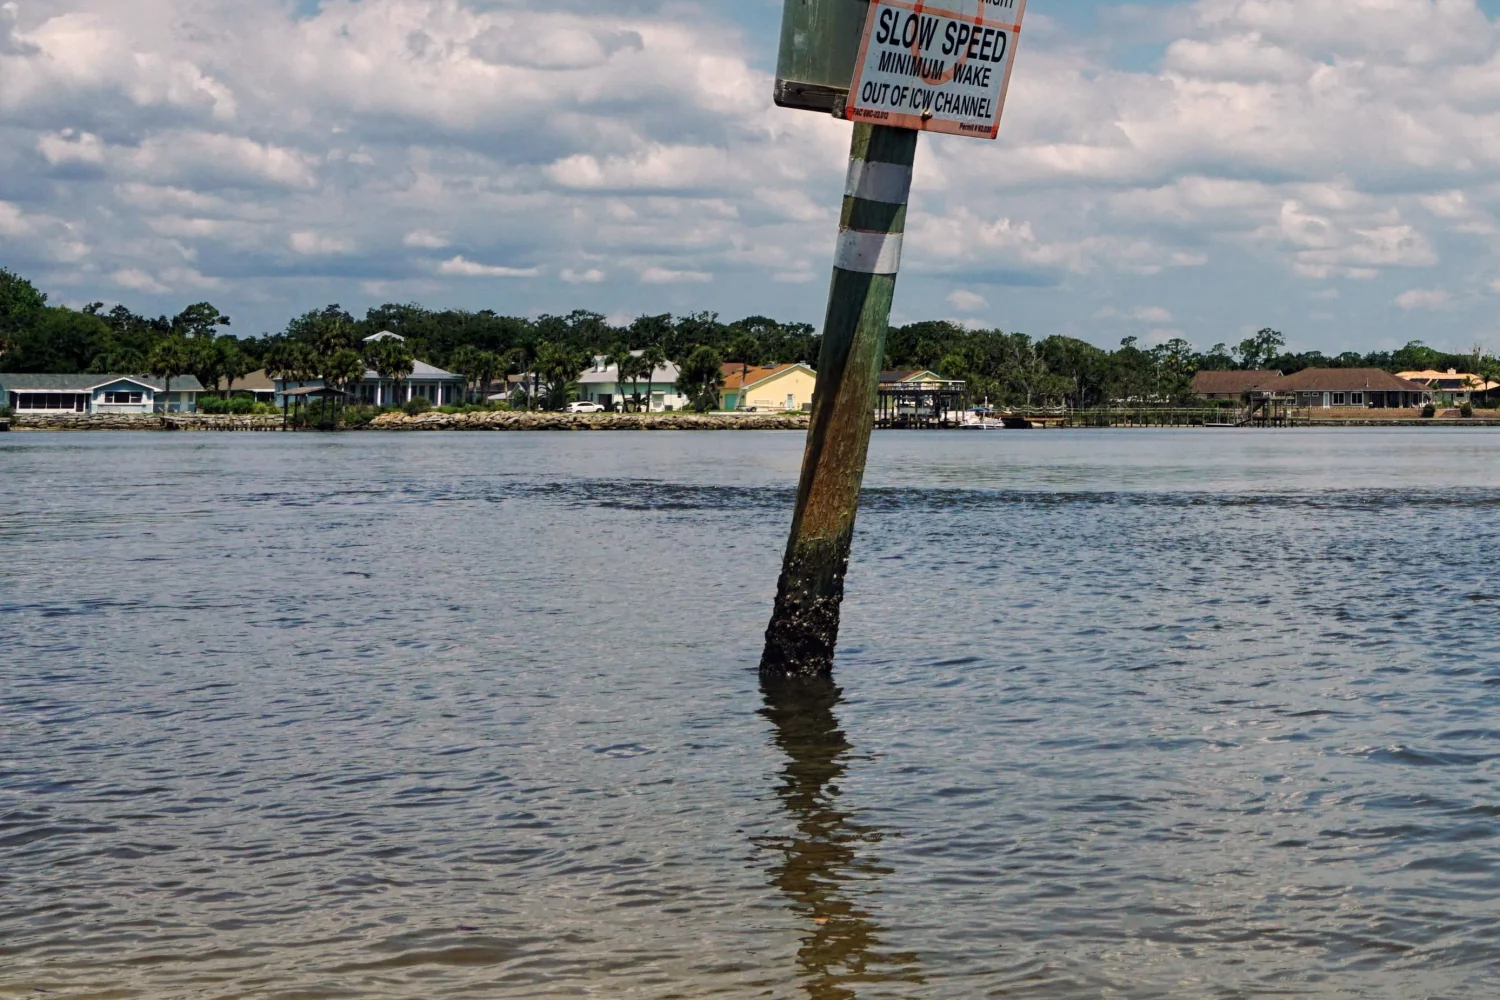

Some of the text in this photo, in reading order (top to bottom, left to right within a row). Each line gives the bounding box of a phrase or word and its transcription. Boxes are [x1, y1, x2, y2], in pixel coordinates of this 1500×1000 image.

[876, 8, 1007, 63] SLOW SPEED
[878, 50, 992, 88] MINIMUM WAKE
[862, 81, 992, 119] OUT OF ICW CHANNEL
